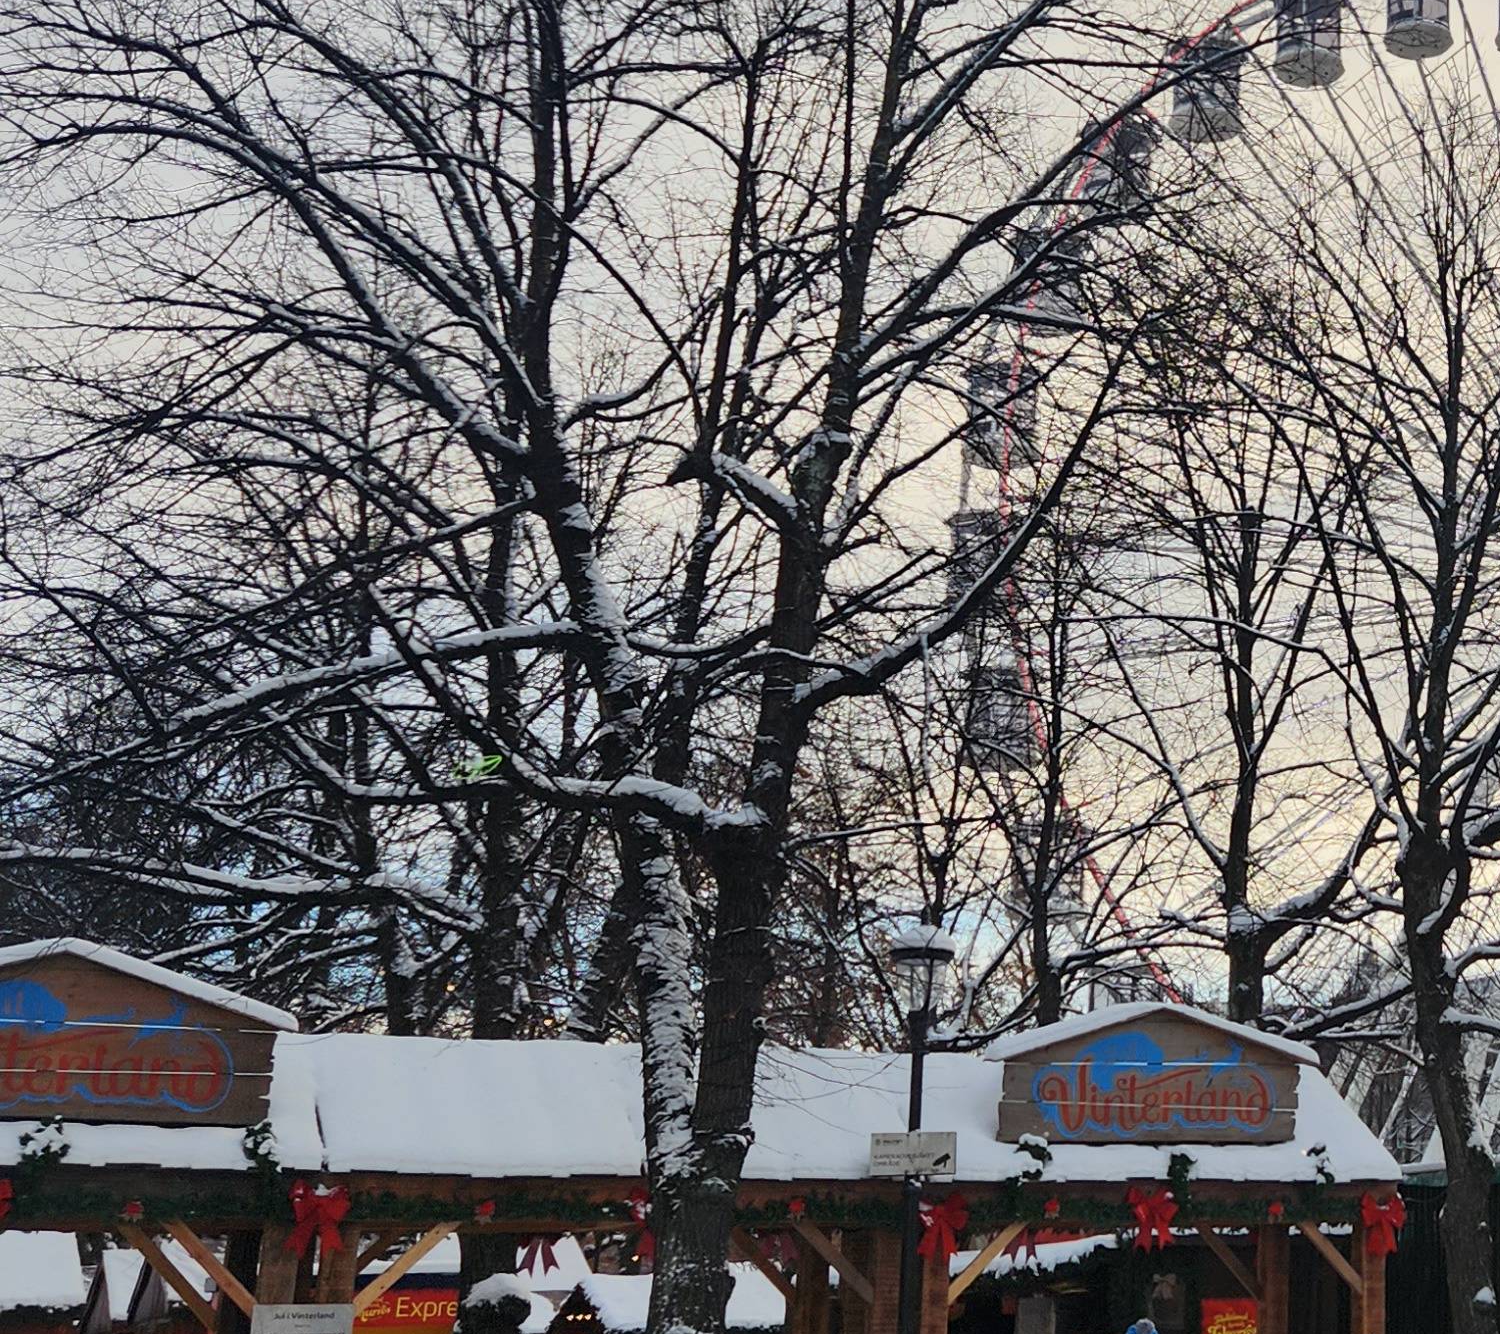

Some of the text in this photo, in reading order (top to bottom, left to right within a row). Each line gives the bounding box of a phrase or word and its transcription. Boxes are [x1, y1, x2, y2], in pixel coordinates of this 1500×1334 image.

[0, 1029, 222, 1103] terland
[1041, 1058, 1268, 1131] Vinterland
[291, 1311, 335, 1320] Vinterland
[396, 1297, 458, 1322] Expre
